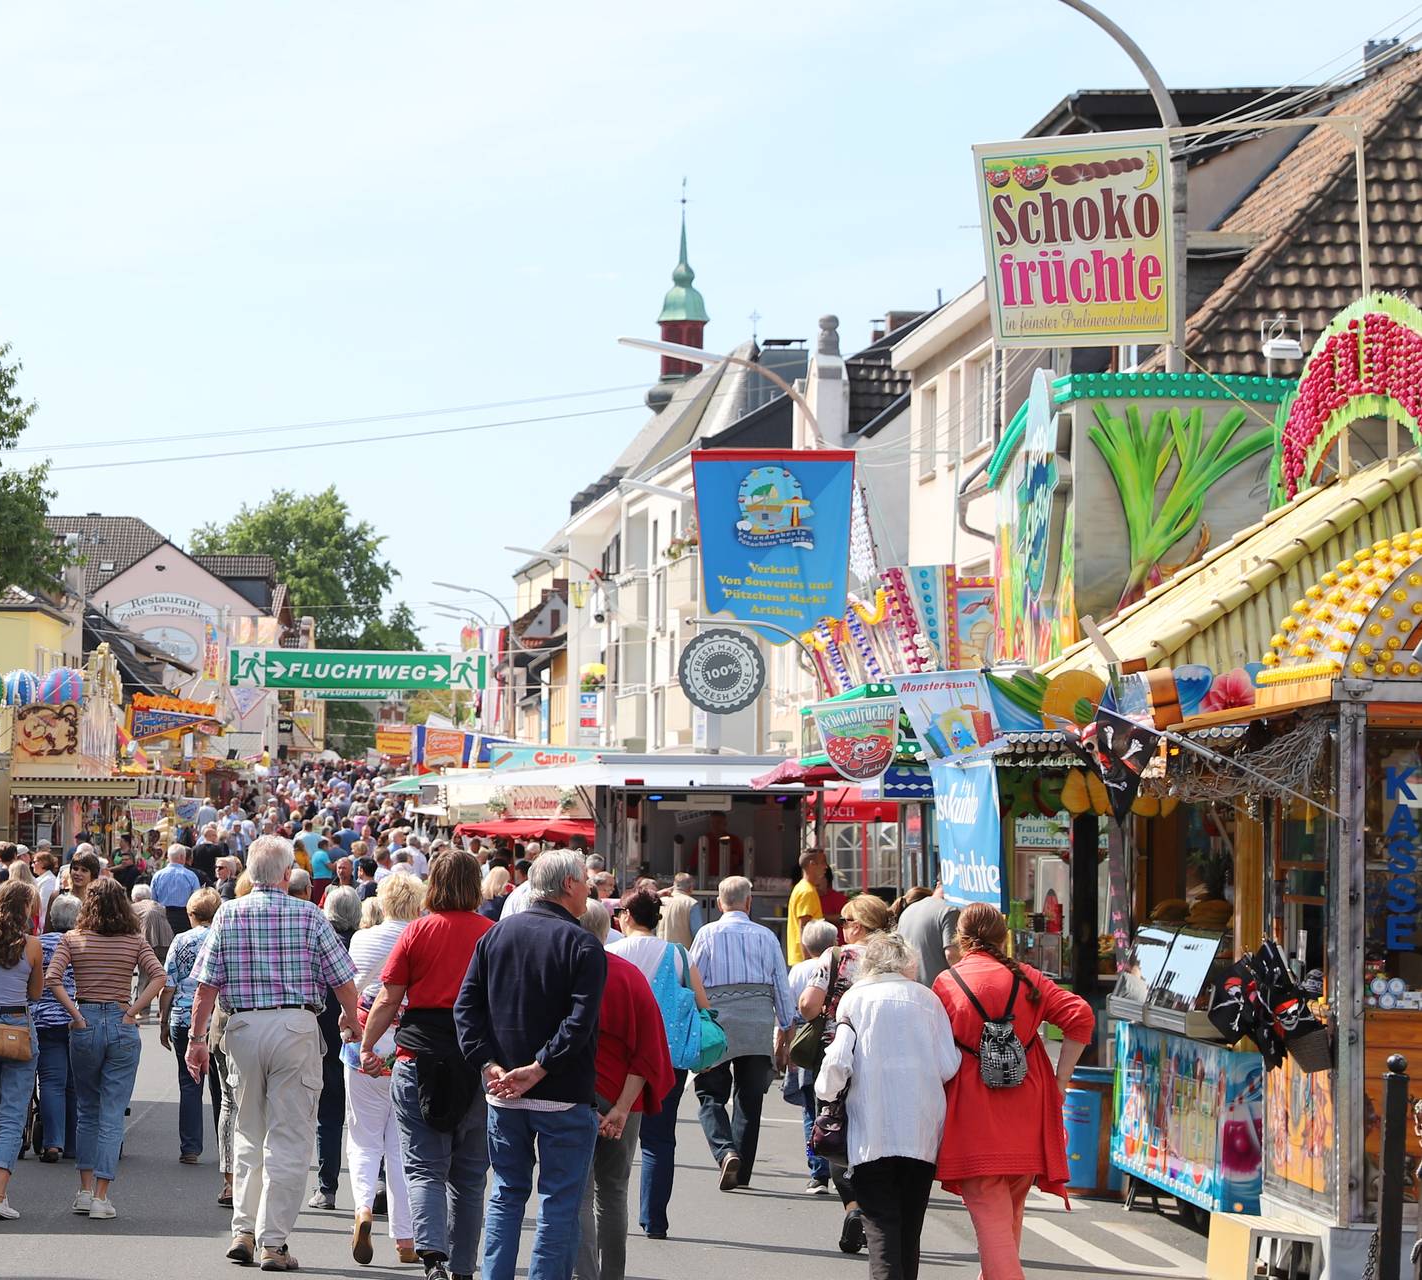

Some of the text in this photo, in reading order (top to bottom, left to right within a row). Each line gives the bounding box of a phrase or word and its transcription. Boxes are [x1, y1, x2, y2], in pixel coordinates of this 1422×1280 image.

[993, 188, 1159, 246] Schoko
[999, 248, 1162, 306] früchte
[1006, 316, 1016, 331] in
[1019, 312, 1058, 333] feinster
[749, 562, 799, 575] Verkauf
[718, 575, 833, 590] Von Souvenirs und
[131, 595, 201, 610] Restaurant
[723, 589, 827, 604] Pützchens Markt
[120, 608, 145, 621] Zum
[751, 605, 803, 617] Artikeln
[694, 644, 745, 672] FRESH MADE
[287, 662, 427, 681] FLUCHTWEG
[705, 662, 739, 680] 100%
[699, 672, 752, 700] FRESH MADE
[900, 681, 976, 693] MonsterSlush
[818, 704, 894, 730] Schokofrüchte
[279, 722, 291, 730] sky
[1022, 835, 1069, 846] Pützchen
[1386, 766, 1419, 950] KASSE
